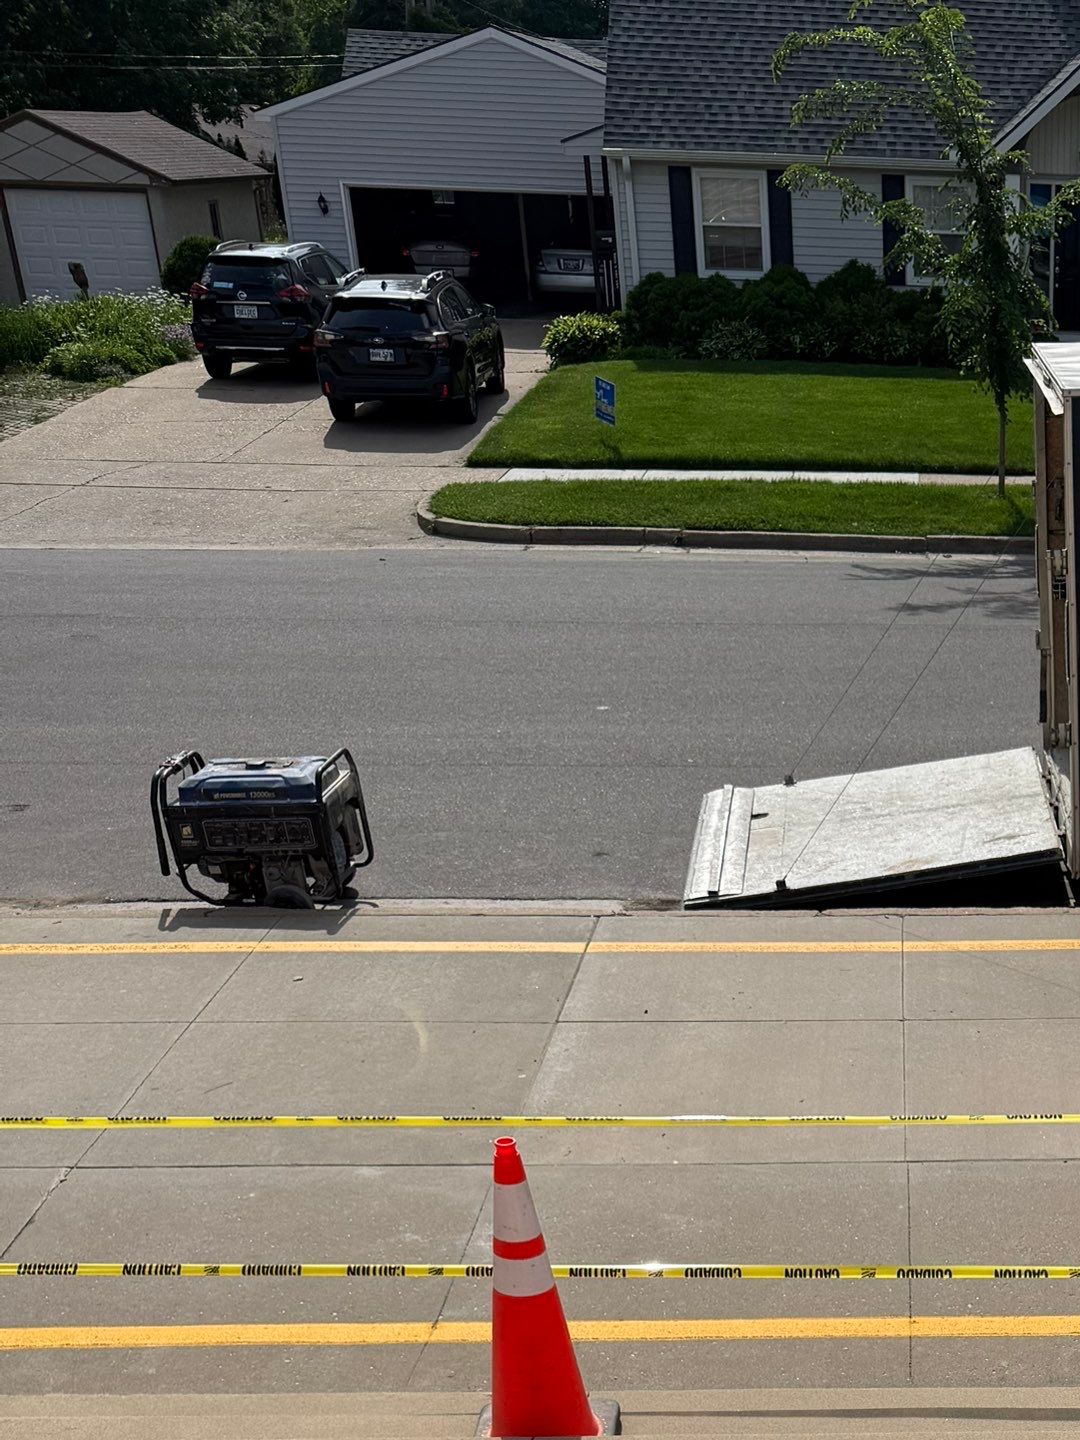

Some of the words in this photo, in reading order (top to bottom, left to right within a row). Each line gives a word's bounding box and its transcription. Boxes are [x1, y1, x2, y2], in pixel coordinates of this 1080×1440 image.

[784, 1268, 841, 1279] CAUTION
[896, 1268, 953, 1279] CUIDADO
[994, 1268, 1049, 1279] CAUTION
